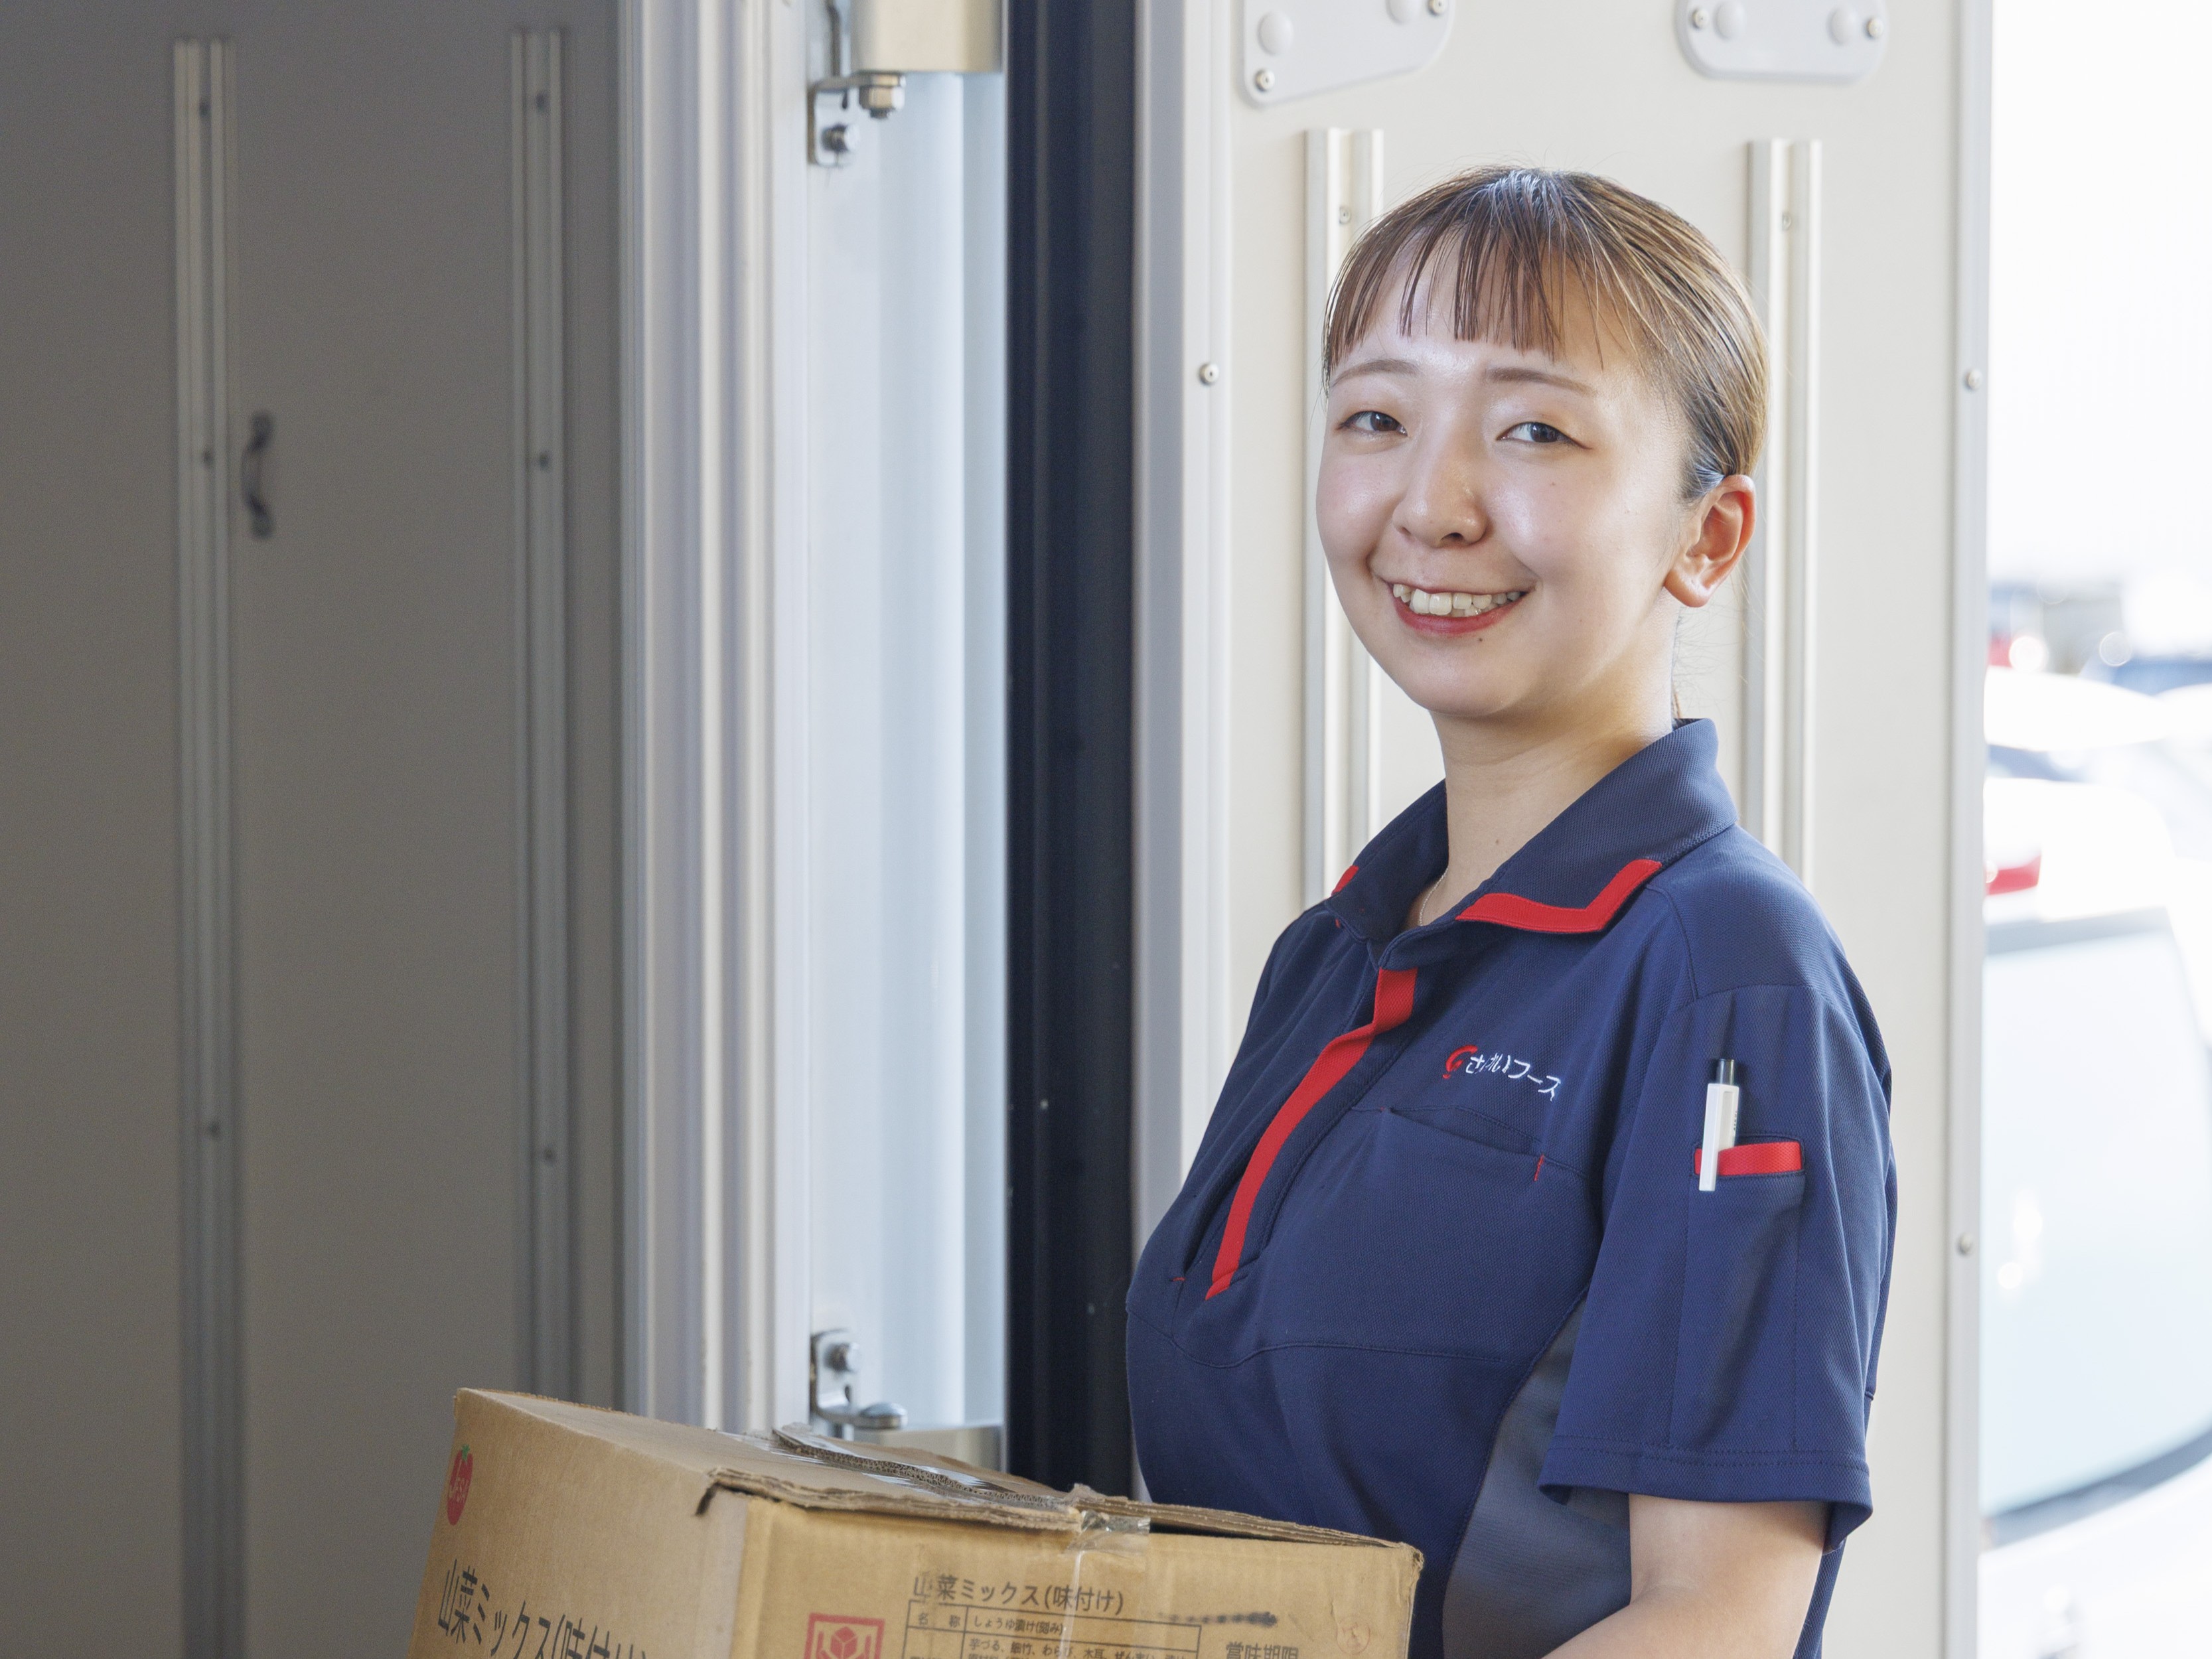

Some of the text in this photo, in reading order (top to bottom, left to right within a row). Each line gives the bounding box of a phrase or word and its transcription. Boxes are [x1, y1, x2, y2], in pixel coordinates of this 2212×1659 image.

[438, 1559, 646, 1659] 山菜ミックス(味
[914, 1571, 1124, 1615] 山菜ミックス(味付け)
